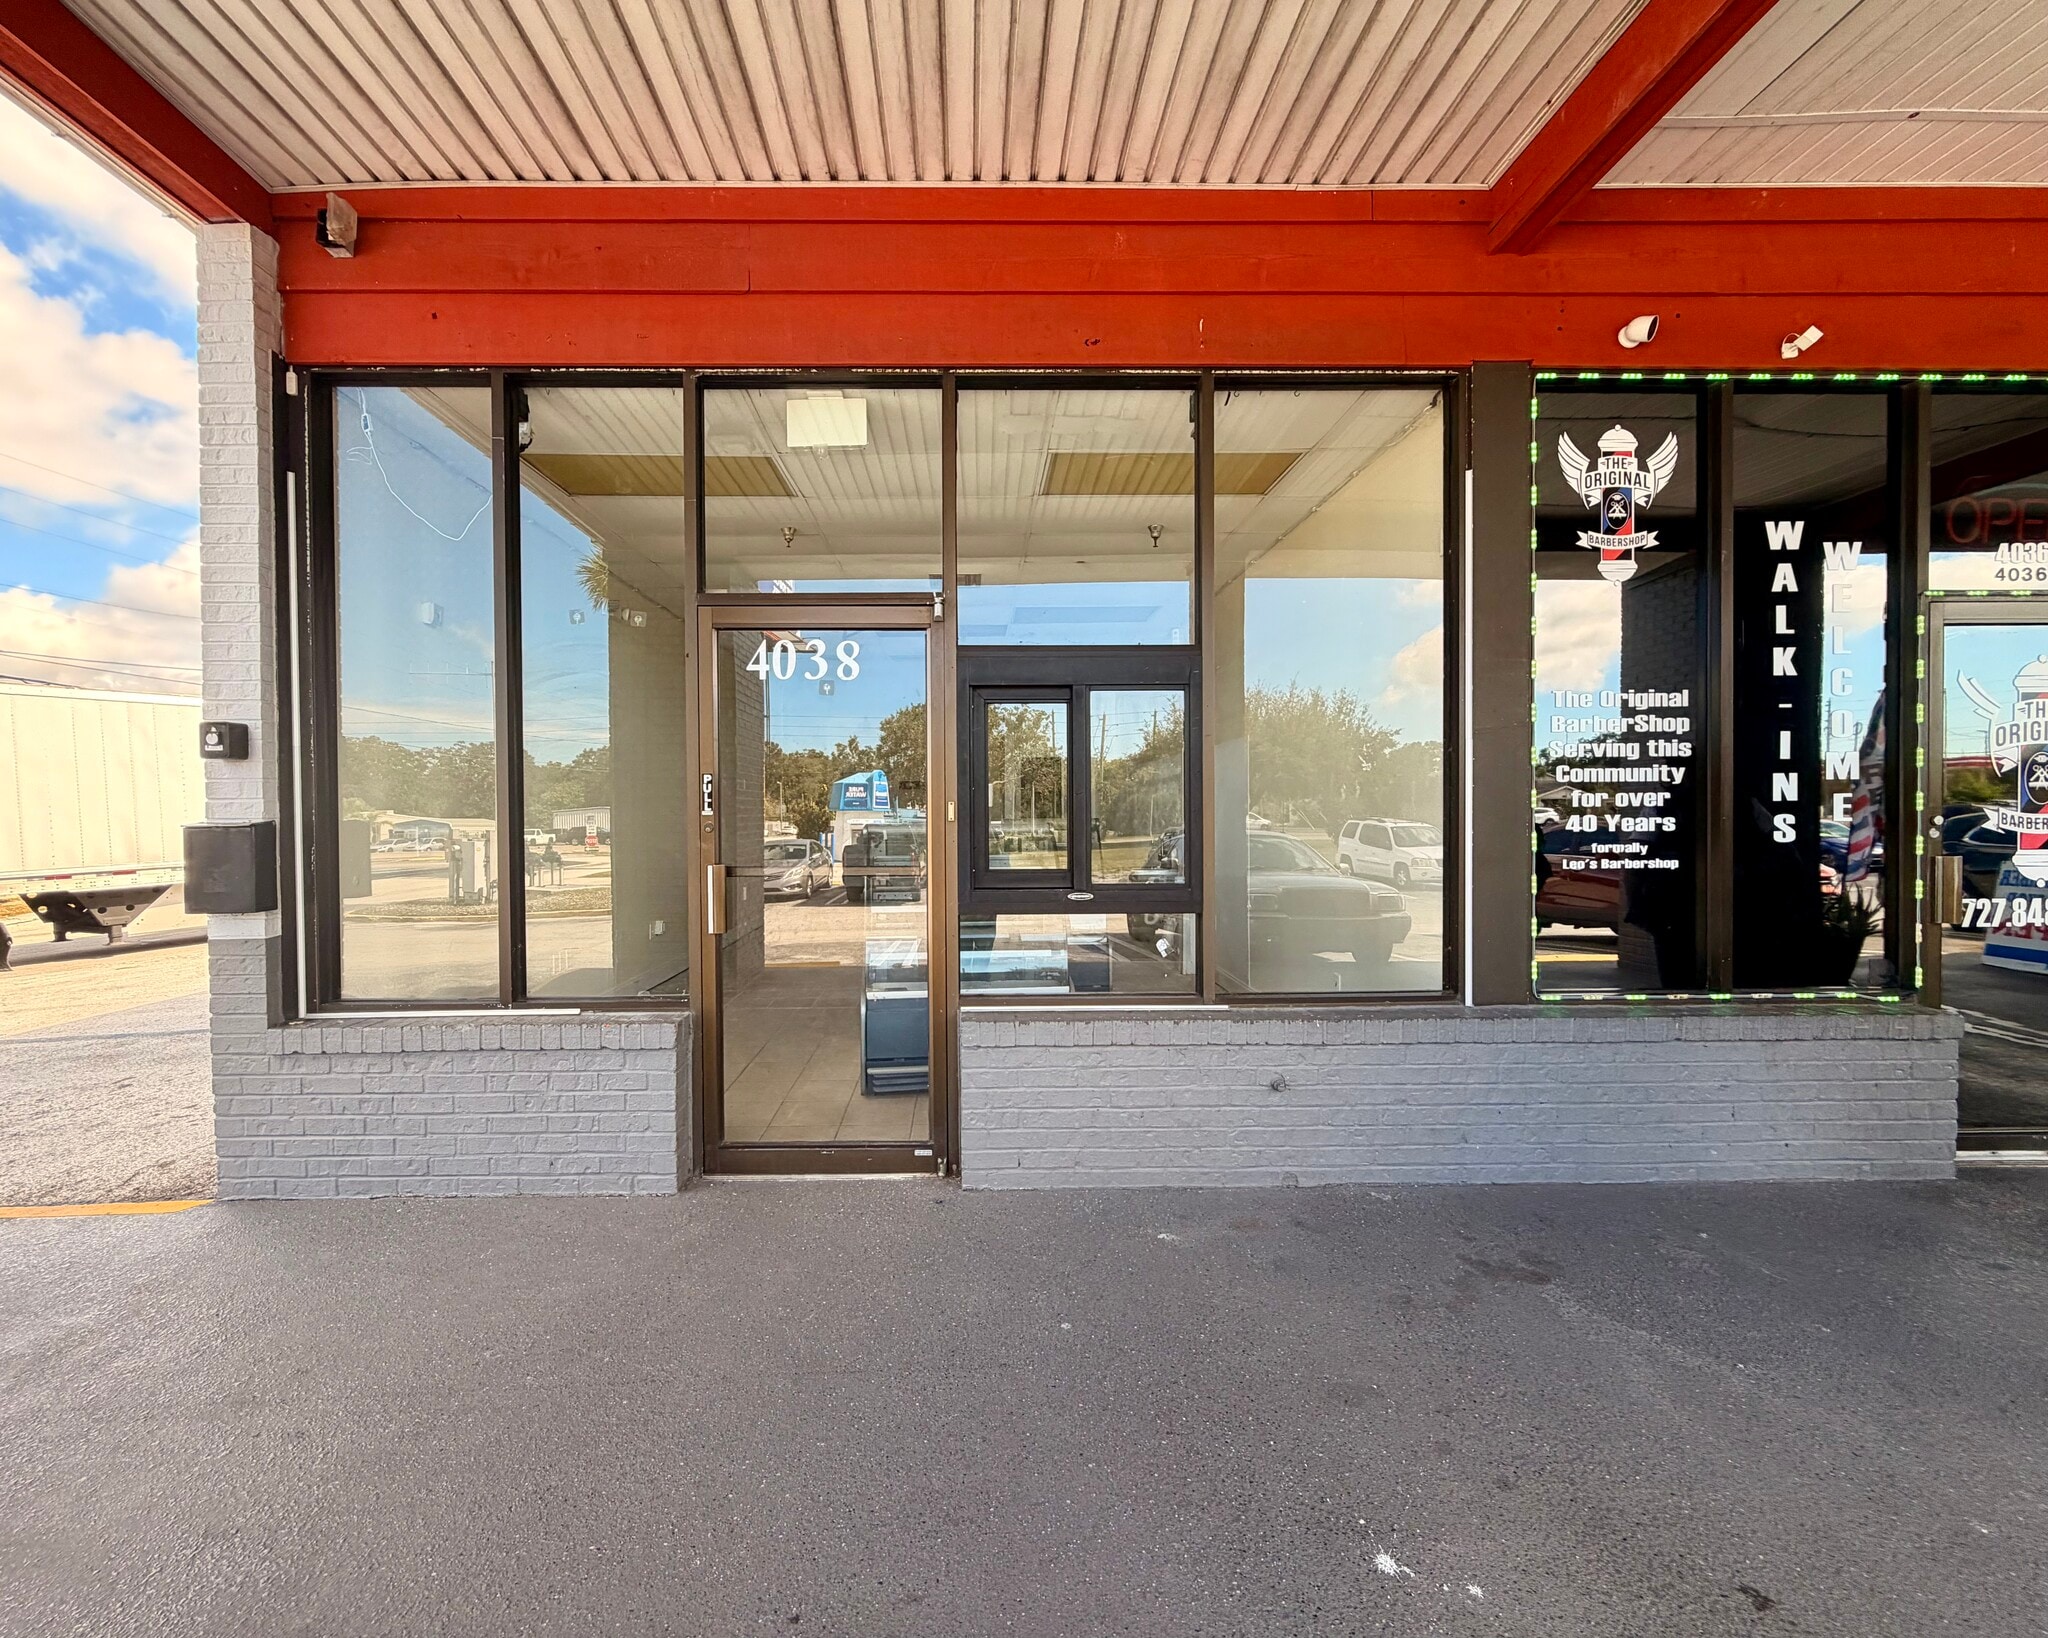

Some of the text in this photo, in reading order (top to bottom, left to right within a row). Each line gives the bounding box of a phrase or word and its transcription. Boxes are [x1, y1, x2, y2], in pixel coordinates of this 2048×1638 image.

[1604, 457, 1629, 470] THE
[1584, 470, 1651, 490] ORIGINAL
[1946, 496, 2048, 546] OPE
[1588, 533, 1647, 548] BARBERSHOP
[1994, 542, 2048, 565] 4036
[1994, 567, 2048, 582] 4036
[745, 638, 861, 682] 4038
[1822, 541, 1863, 823] WELCOME
[1552, 688, 1690, 710] The Original
[1550, 714, 1691, 735] BarberShop
[1549, 739, 1693, 761] Serving this
[1555, 764, 1686, 785] Community
[702, 774, 713, 811] PULL
[1571, 789, 1671, 808] for over
[1565, 814, 1677, 833] 40 Years
[1591, 842, 1649, 856] formally
[1562, 858, 1680, 870] Leo's Barbershop
[1961, 897, 2048, 928] 727.84
